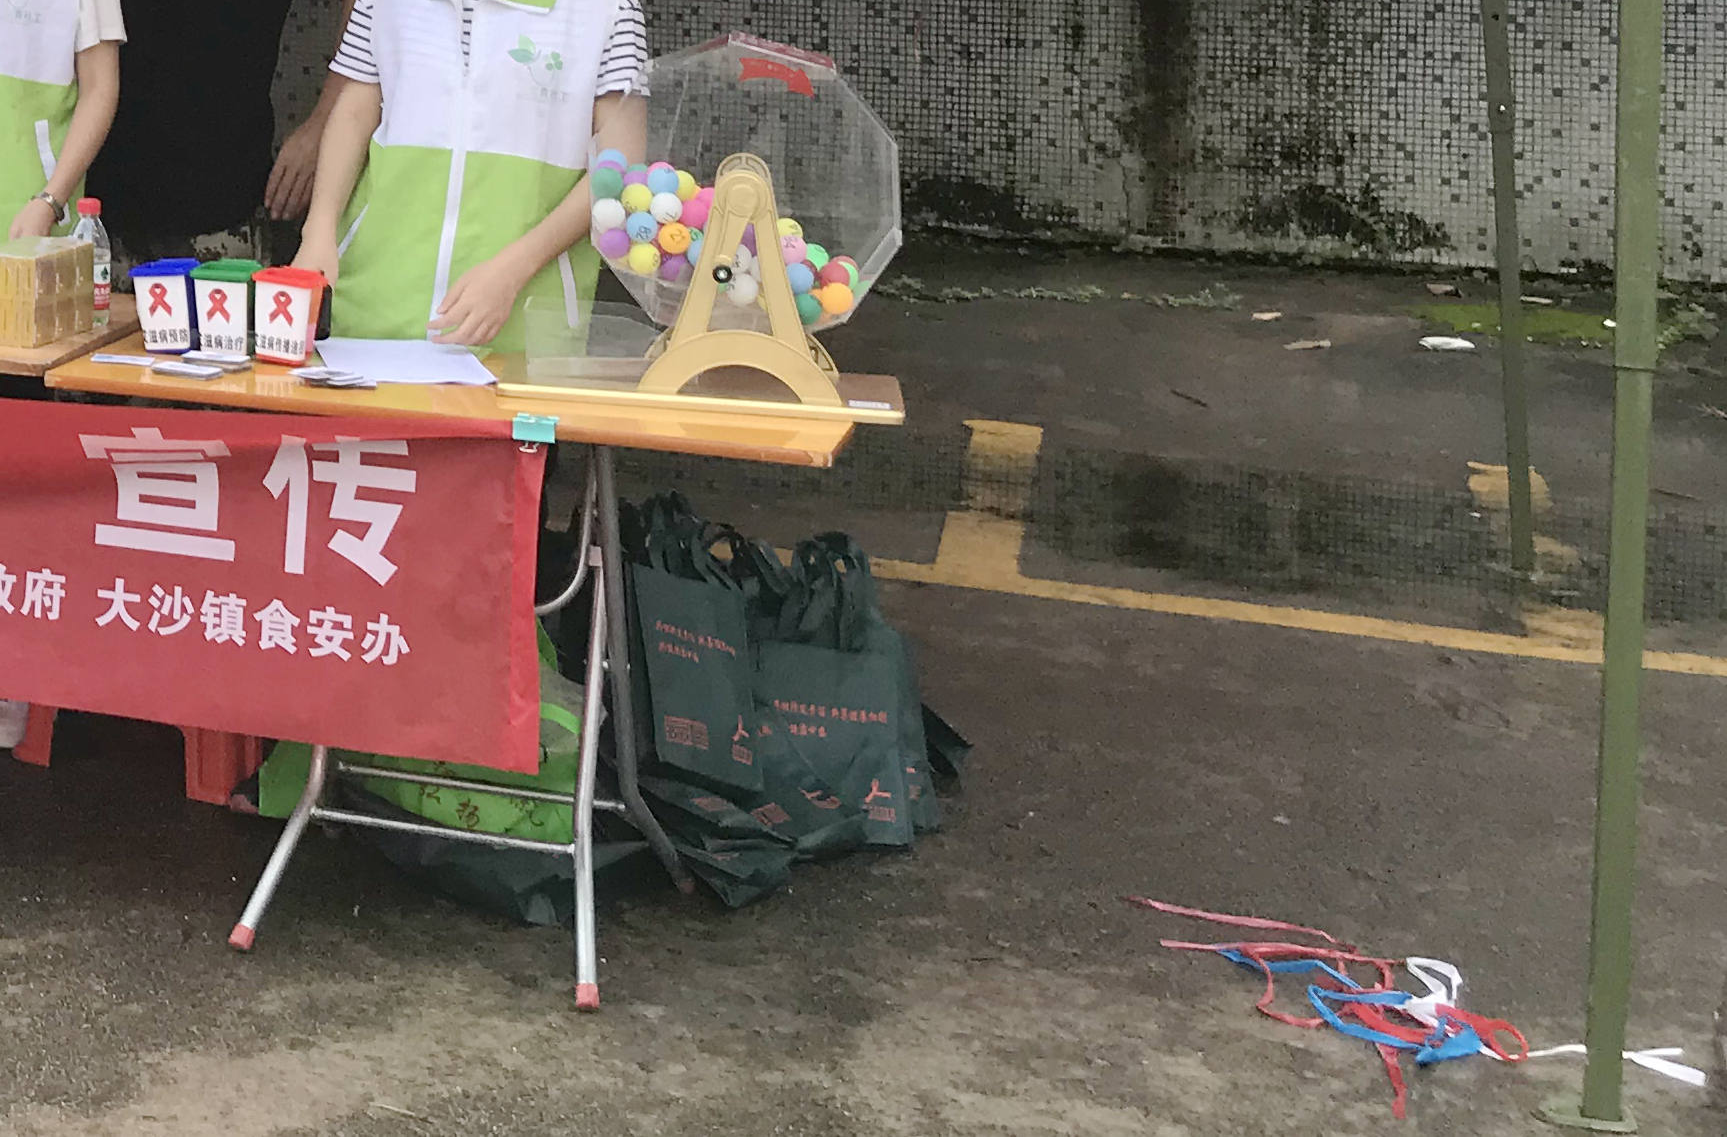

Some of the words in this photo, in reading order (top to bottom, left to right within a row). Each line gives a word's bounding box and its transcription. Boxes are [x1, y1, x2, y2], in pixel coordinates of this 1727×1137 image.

[77, 425, 419, 588] 宣传
[94, 576, 412, 667] 大沙镇食安办
